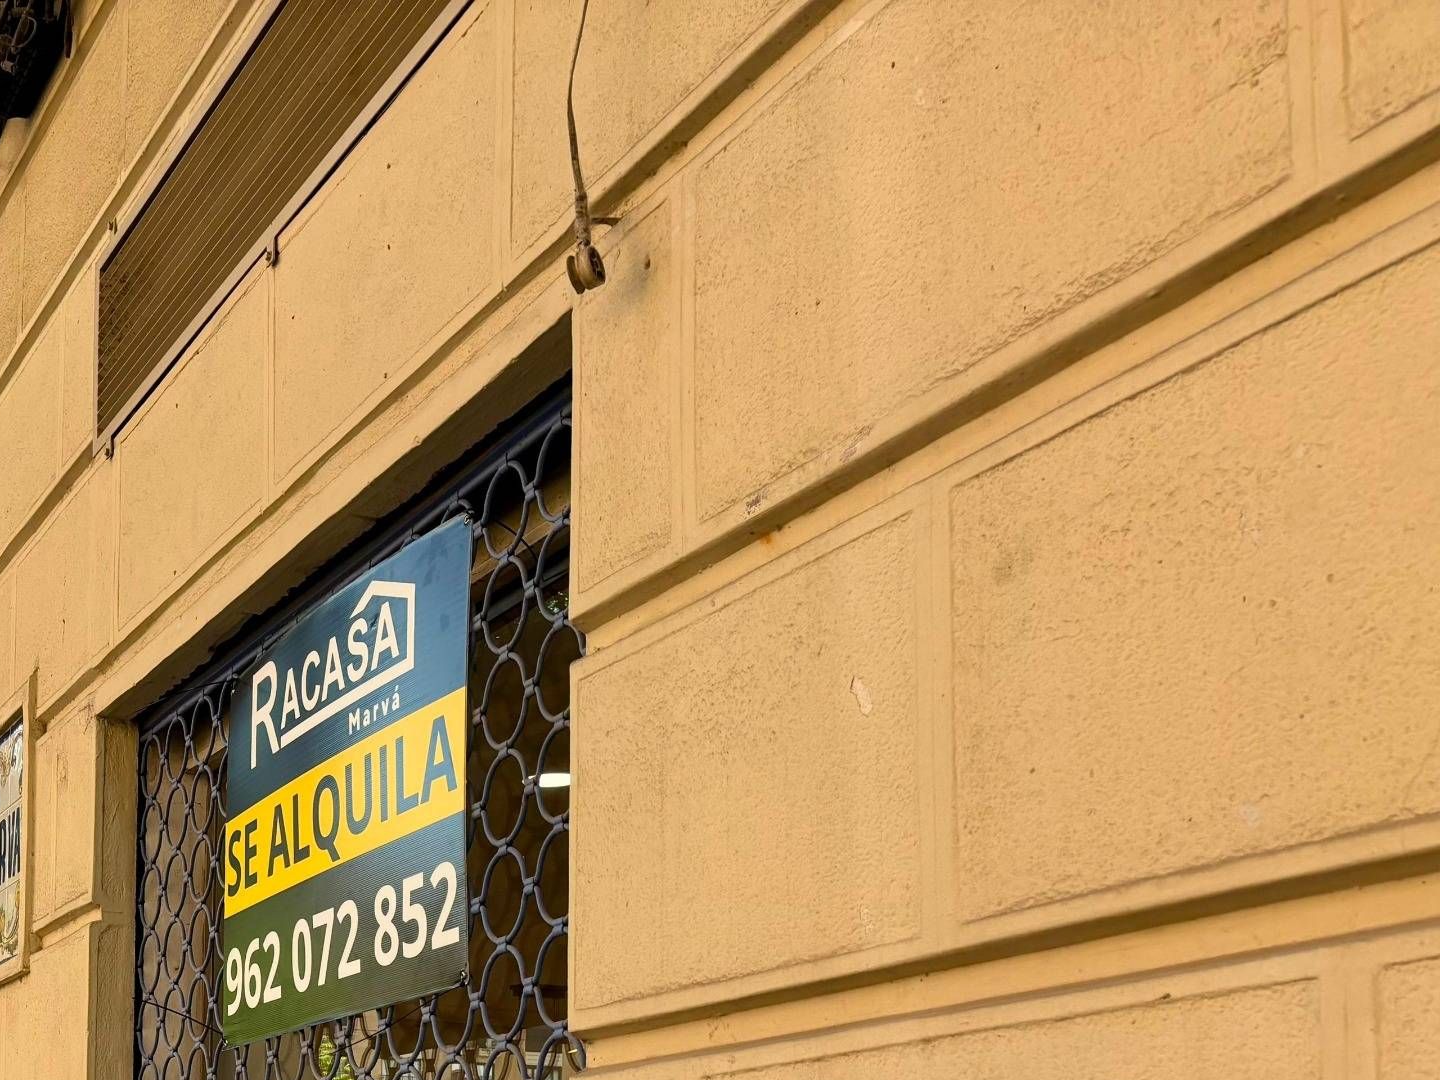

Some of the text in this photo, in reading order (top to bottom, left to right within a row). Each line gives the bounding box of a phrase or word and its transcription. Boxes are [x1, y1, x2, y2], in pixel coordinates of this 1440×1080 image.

[250, 601, 400, 770] RACASA
[348, 685, 401, 736] Marvá
[226, 715, 457, 898] SE ALQUILA
[226, 861, 460, 1016] 962 072 852
